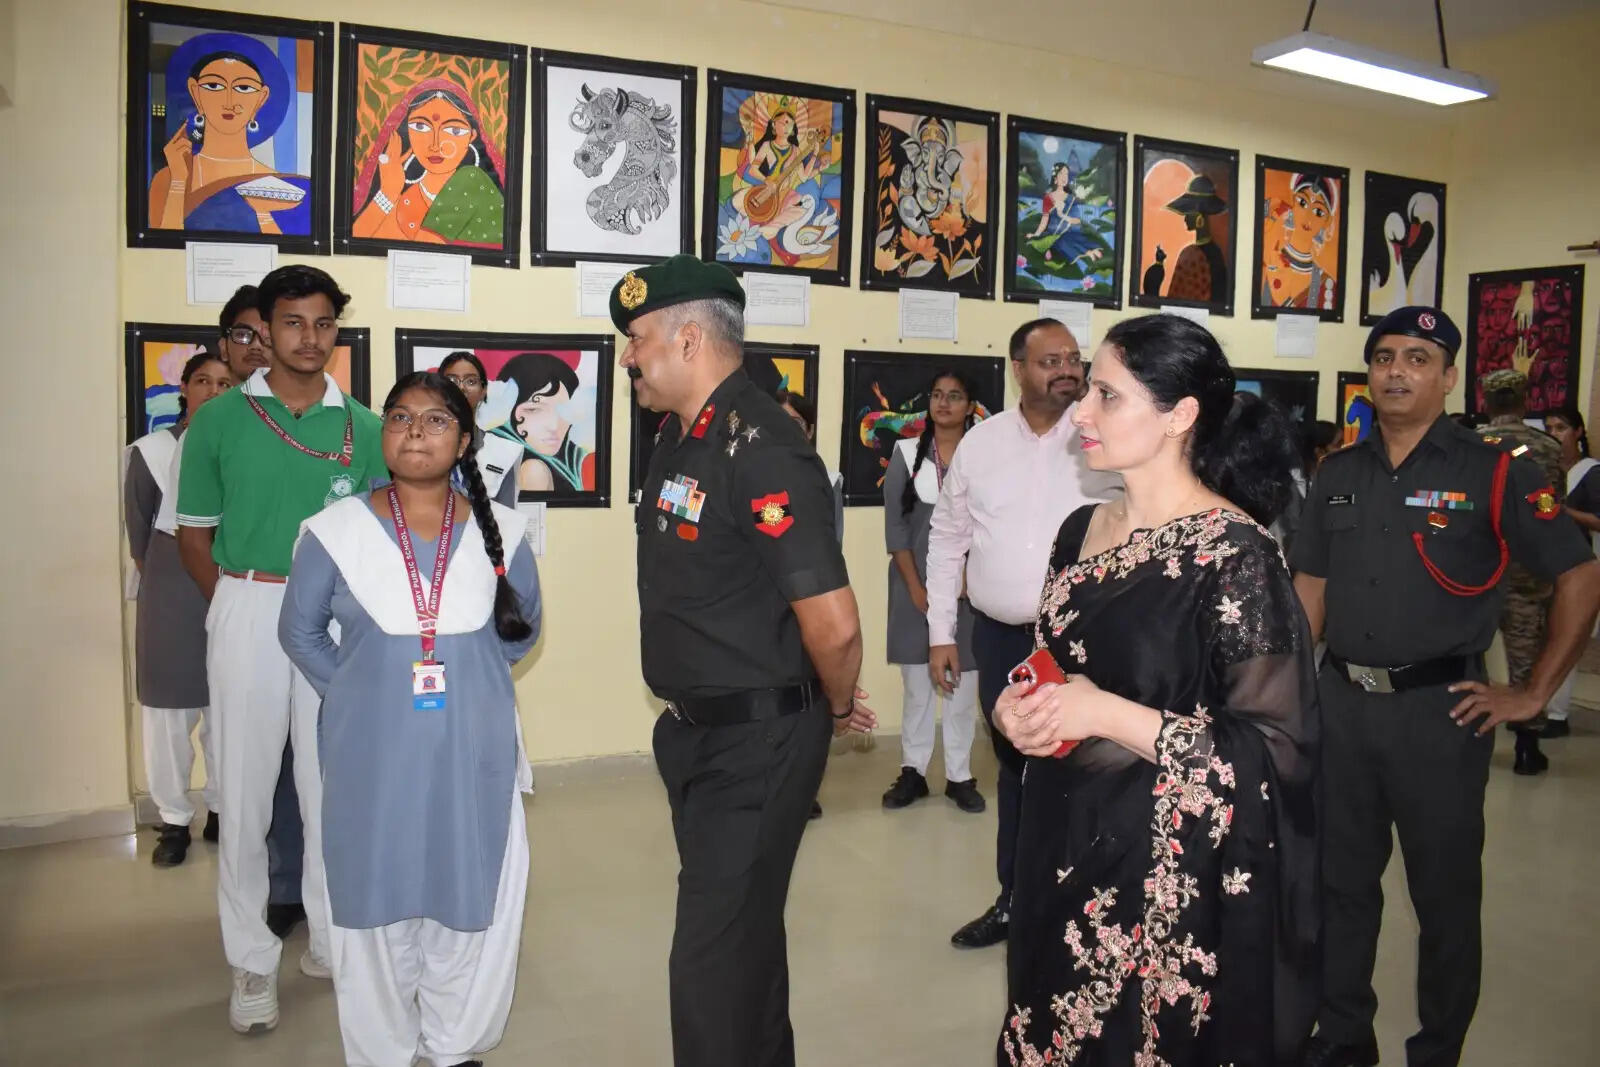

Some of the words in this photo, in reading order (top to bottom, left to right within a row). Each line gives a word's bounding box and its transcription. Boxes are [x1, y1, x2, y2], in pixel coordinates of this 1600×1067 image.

[408, 561, 420, 588] PUBLIC
[434, 560, 444, 586] PUBLIC
[415, 589, 425, 611] ARMY
[430, 588, 439, 610] ARMY
